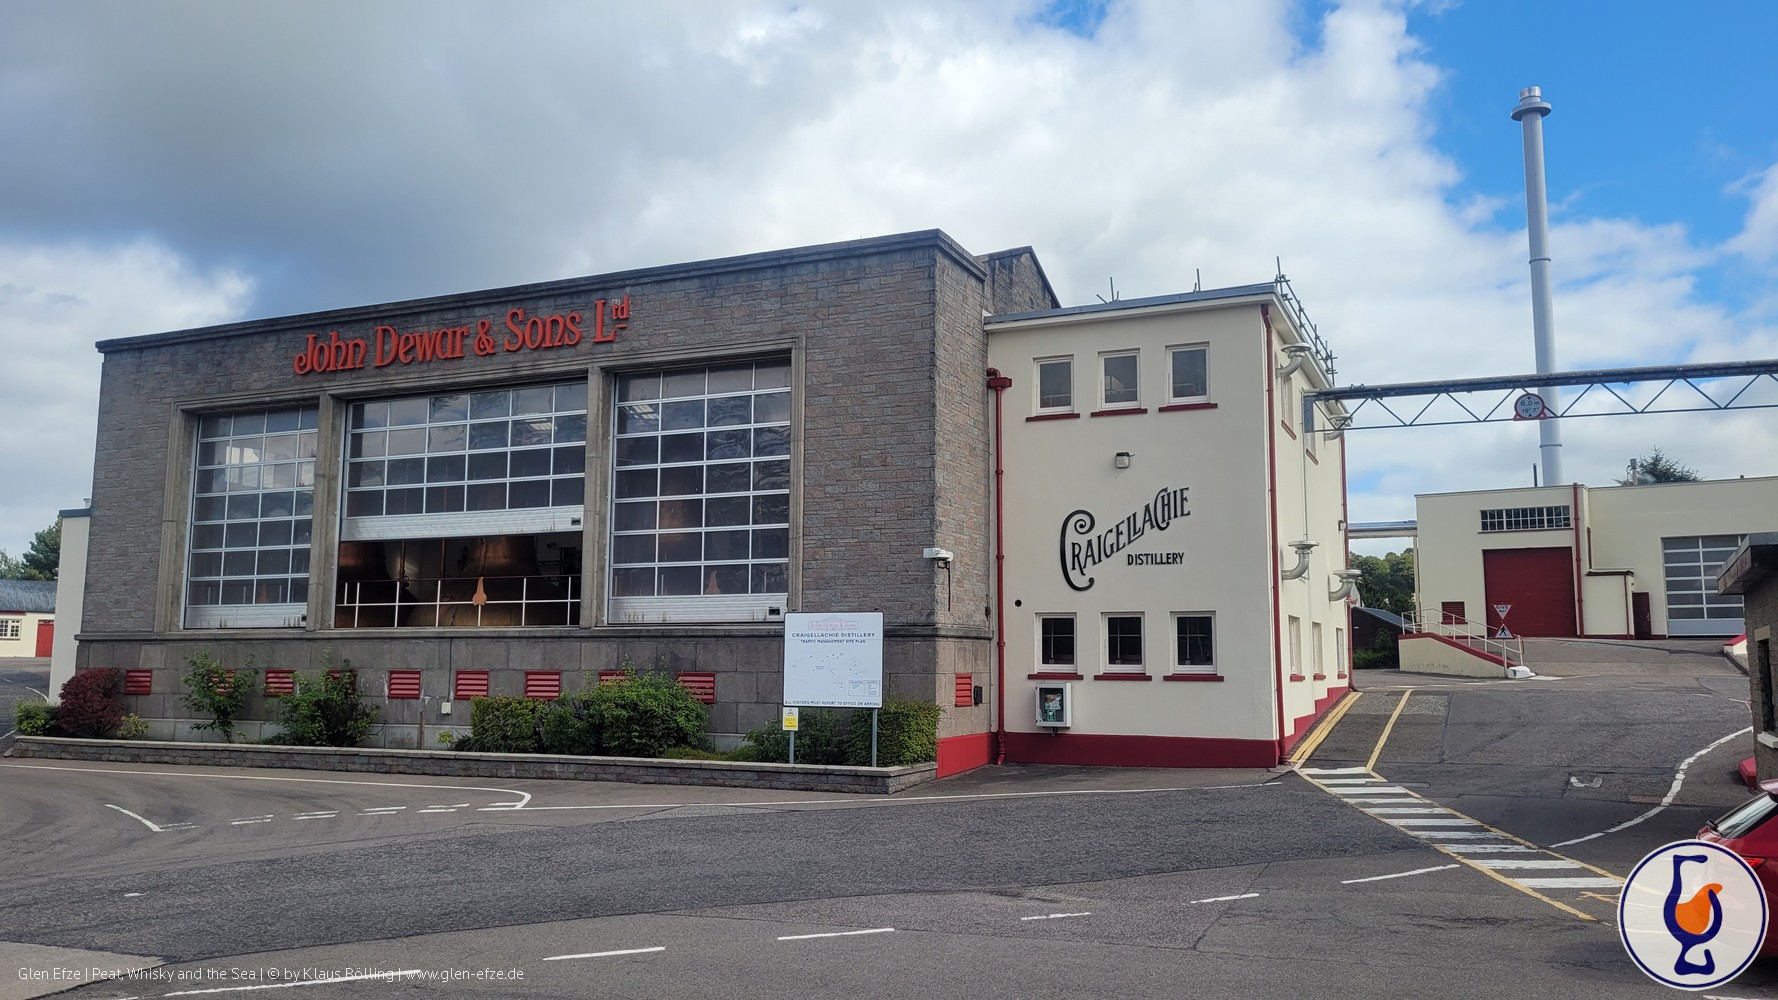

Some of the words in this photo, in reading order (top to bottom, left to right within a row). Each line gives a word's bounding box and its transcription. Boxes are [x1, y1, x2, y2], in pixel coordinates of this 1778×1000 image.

[293, 332, 367, 375] John
[373, 325, 470, 367] Dewar
[472, 319, 496, 357] &
[504, 308, 582, 351] Sons
[592, 294, 630, 343] Ltd
[1060, 487, 1191, 592] CRAIGELLACHIE
[1127, 552, 1185, 566] DISTILLERY
